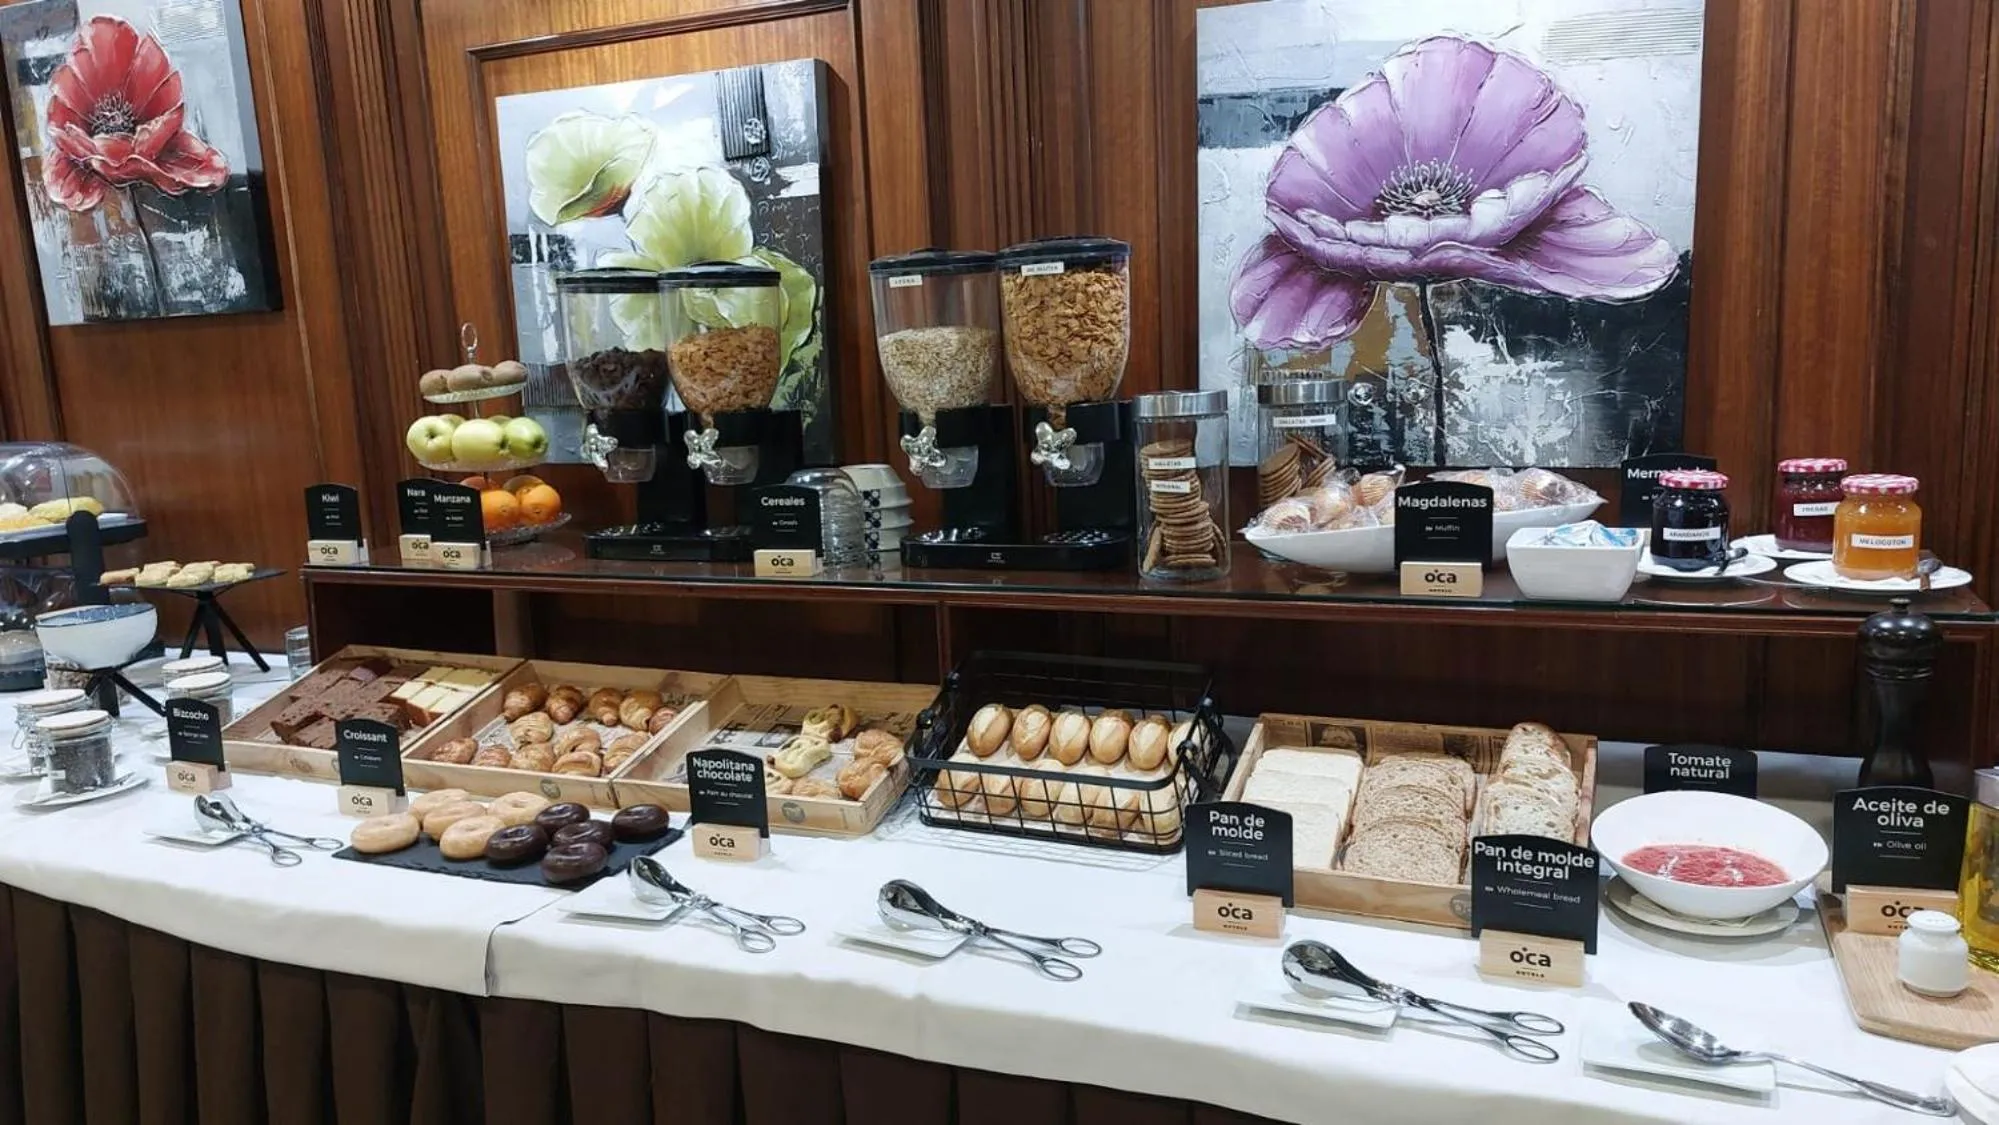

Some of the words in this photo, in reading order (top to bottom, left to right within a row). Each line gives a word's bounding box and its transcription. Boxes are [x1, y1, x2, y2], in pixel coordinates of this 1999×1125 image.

[322, 493, 339, 502] Kiwi
[434, 494, 471, 504] Manzana
[761, 496, 805, 506] Cereales
[1398, 496, 1487, 510] Magdalenas
[1435, 524, 1460, 532] Muffin
[173, 707, 209, 721] Bizcocho
[343, 730, 388, 743] Croissant
[693, 757, 755, 772] Napolitana
[1668, 752, 1732, 767] Tomate
[697, 769, 753, 782] chocolate
[1670, 766, 1729, 779] natural
[1852, 797, 1918, 813] Aceite
[1923, 800, 1950, 815] de
[1209, 810, 1239, 825] Pan
[1244, 813, 1265, 828] de
[1877, 812, 1924, 828] oliva
[1212, 826, 1264, 841] molde
[1886, 840, 1912, 849] Olive
[1914, 842, 1927, 851] oil
[1244, 851, 1268, 861] bread
[1474, 841, 1506, 858] Pan
[1511, 846, 1533, 861] de
[1538, 851, 1595, 868] molde
[1497, 857, 1569, 880] integral
[1497, 886, 1551, 899] Wholemeal
[1553, 893, 1580, 904] bread
[1881, 901, 1925, 918] oc
